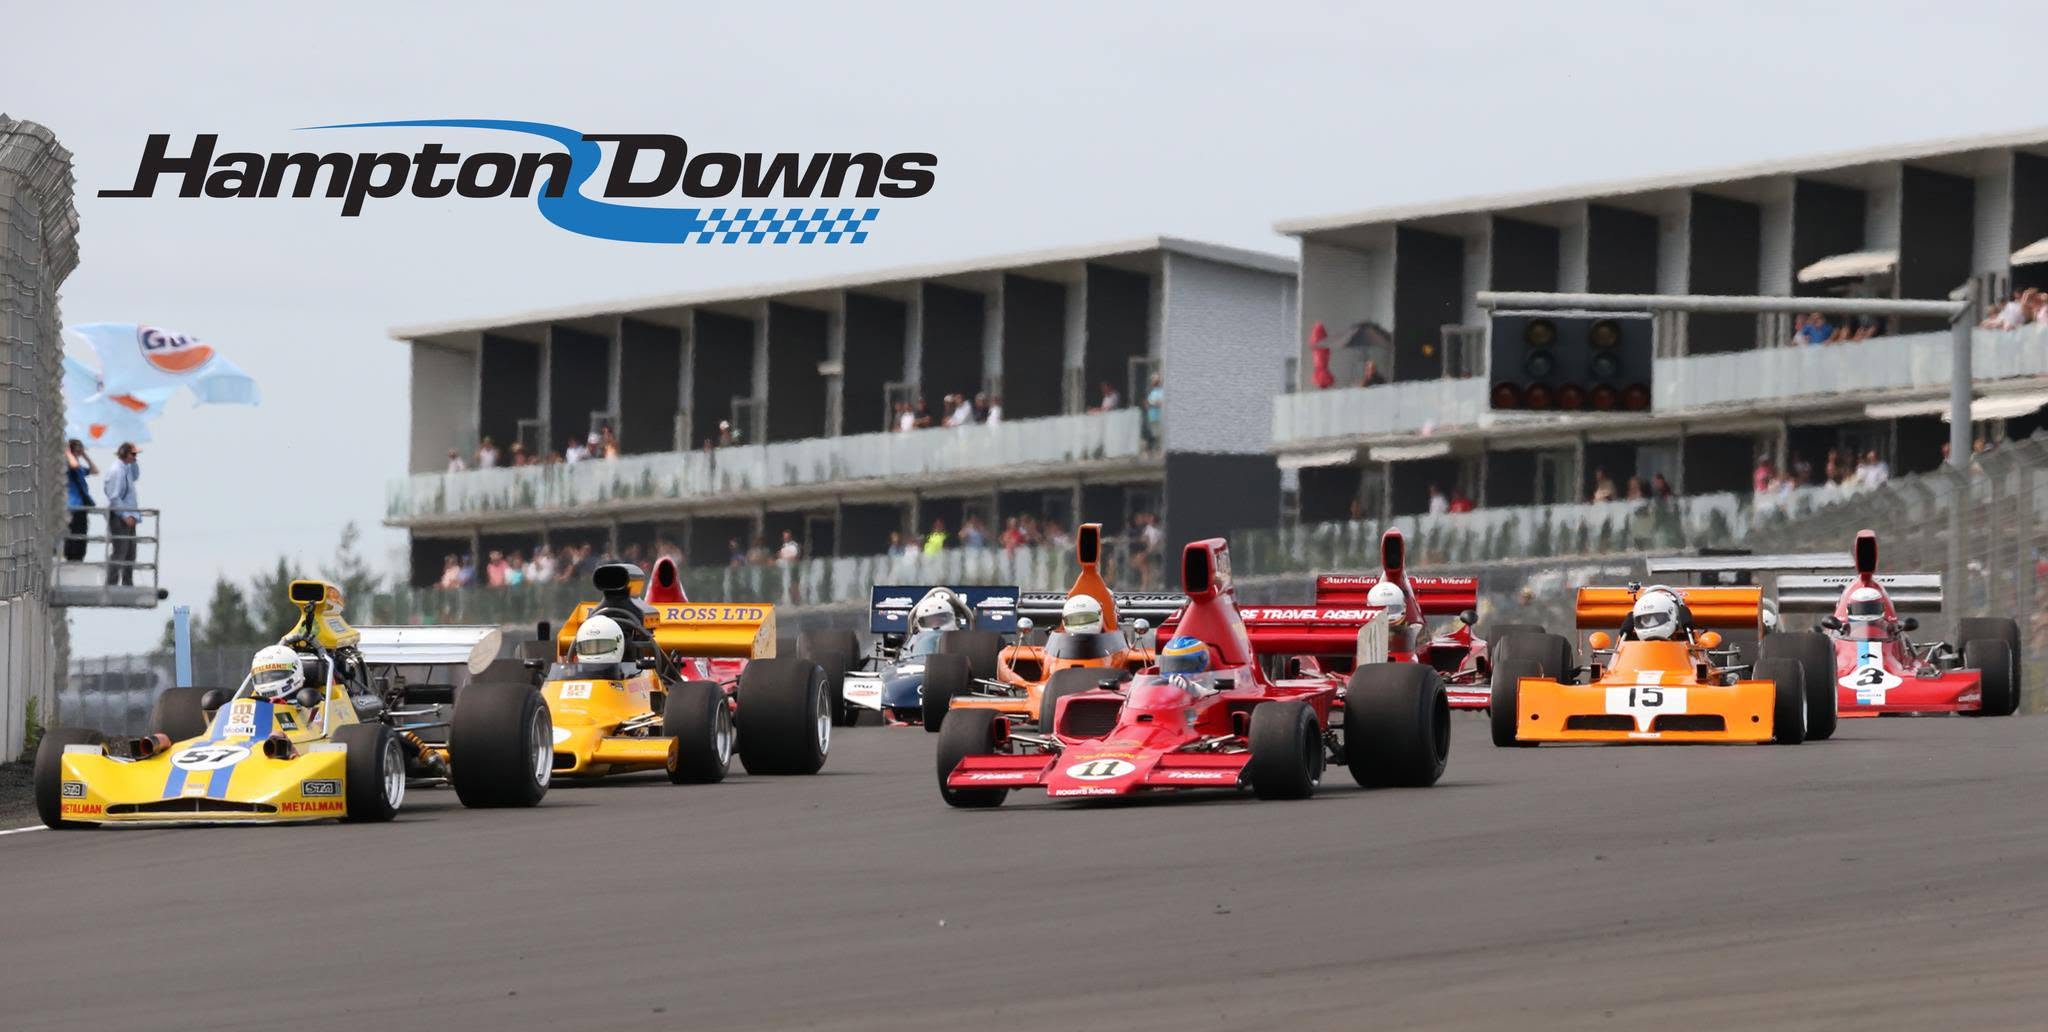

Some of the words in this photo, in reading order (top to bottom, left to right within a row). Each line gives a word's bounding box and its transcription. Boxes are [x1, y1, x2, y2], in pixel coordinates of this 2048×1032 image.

[143, 329, 198, 350] Gu
[1324, 576, 1377, 585] Australian
[1415, 577, 1437, 585] Wire
[1441, 577, 1472, 585] Wheels
[666, 608, 717, 620] ROSS
[723, 608, 763, 620] LTD
[1262, 609, 1322, 620] TRAVEL
[1322, 609, 1382, 620] AGENTS
[1856, 668, 1884, 686] 3
[1629, 687, 1664, 708] 15
[177, 748, 242, 764] 57
[1076, 761, 1120, 777] 11
[305, 782, 334, 794] STA
[281, 801, 344, 813] METALMAN
